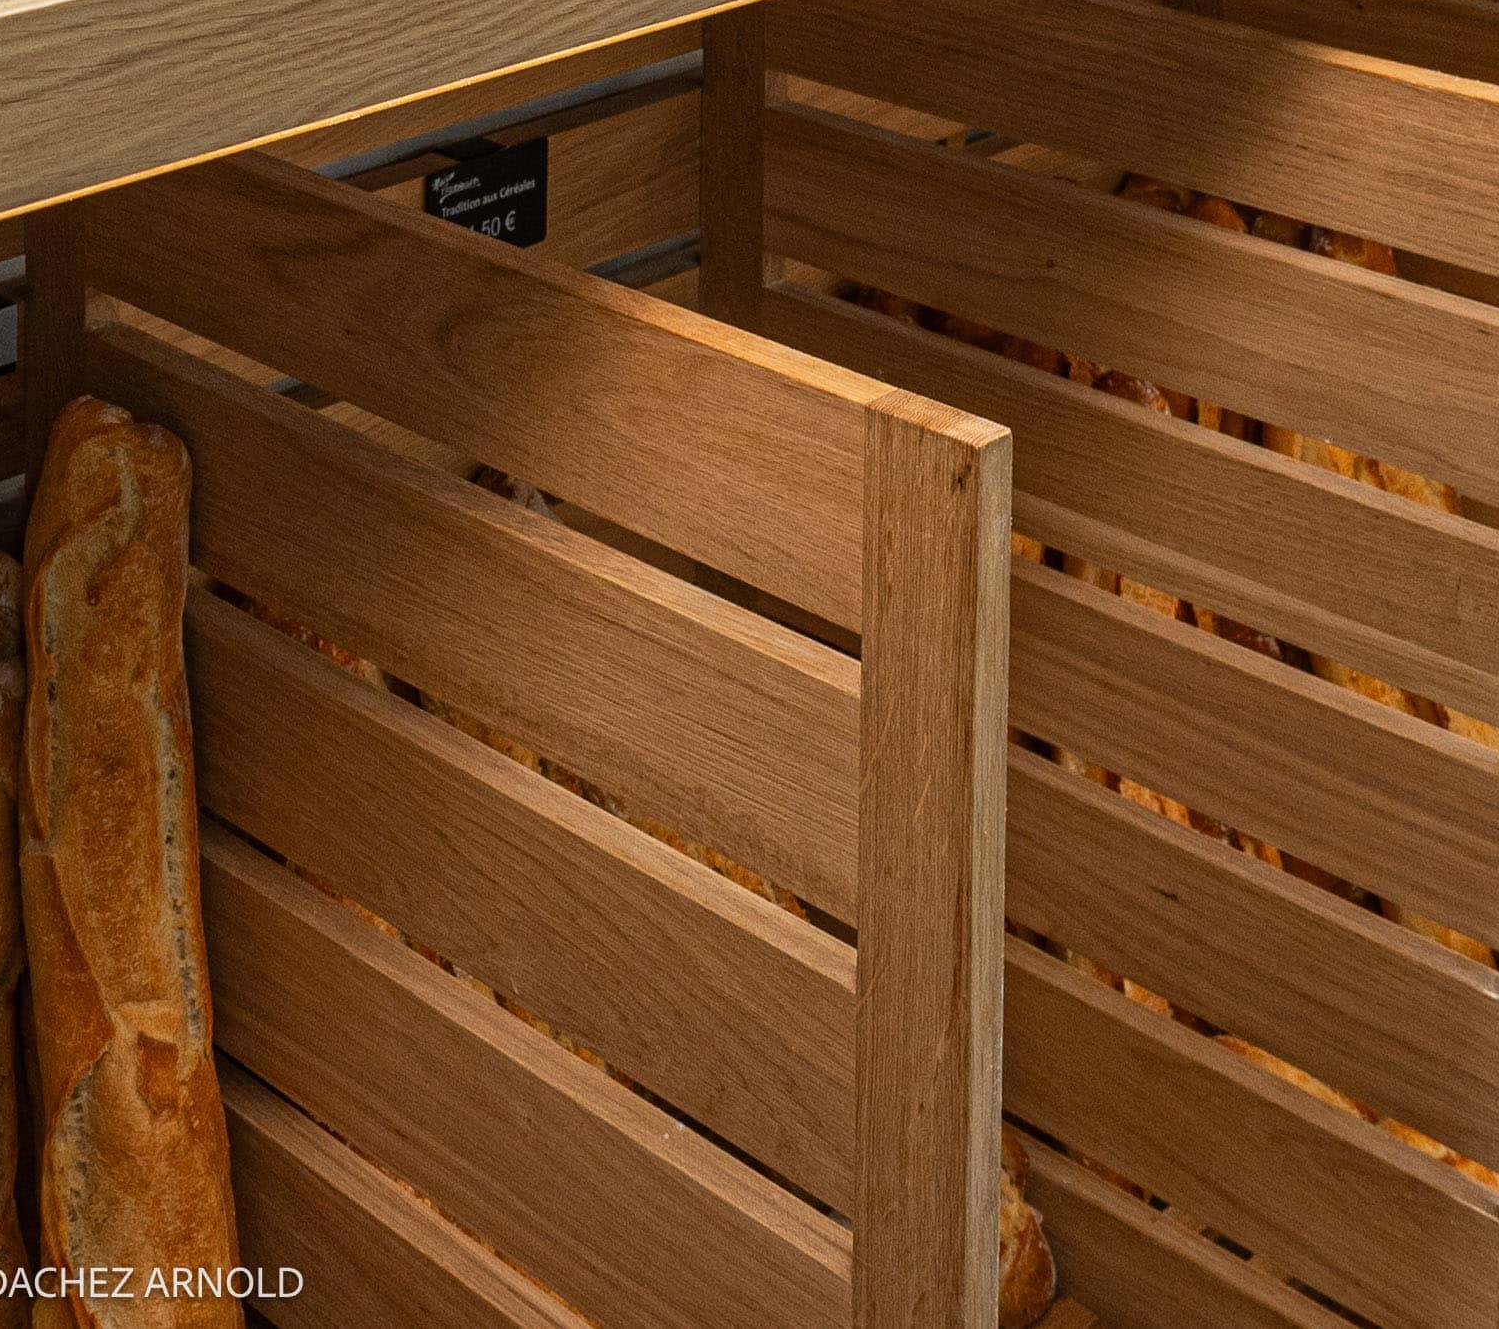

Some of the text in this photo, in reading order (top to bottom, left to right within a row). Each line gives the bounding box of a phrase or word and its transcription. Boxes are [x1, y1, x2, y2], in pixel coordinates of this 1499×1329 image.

[442, 197, 481, 217] Tradition
[482, 192, 498, 204] aux
[499, 179, 536, 199] Céréales
[505, 210, 516, 231] €
